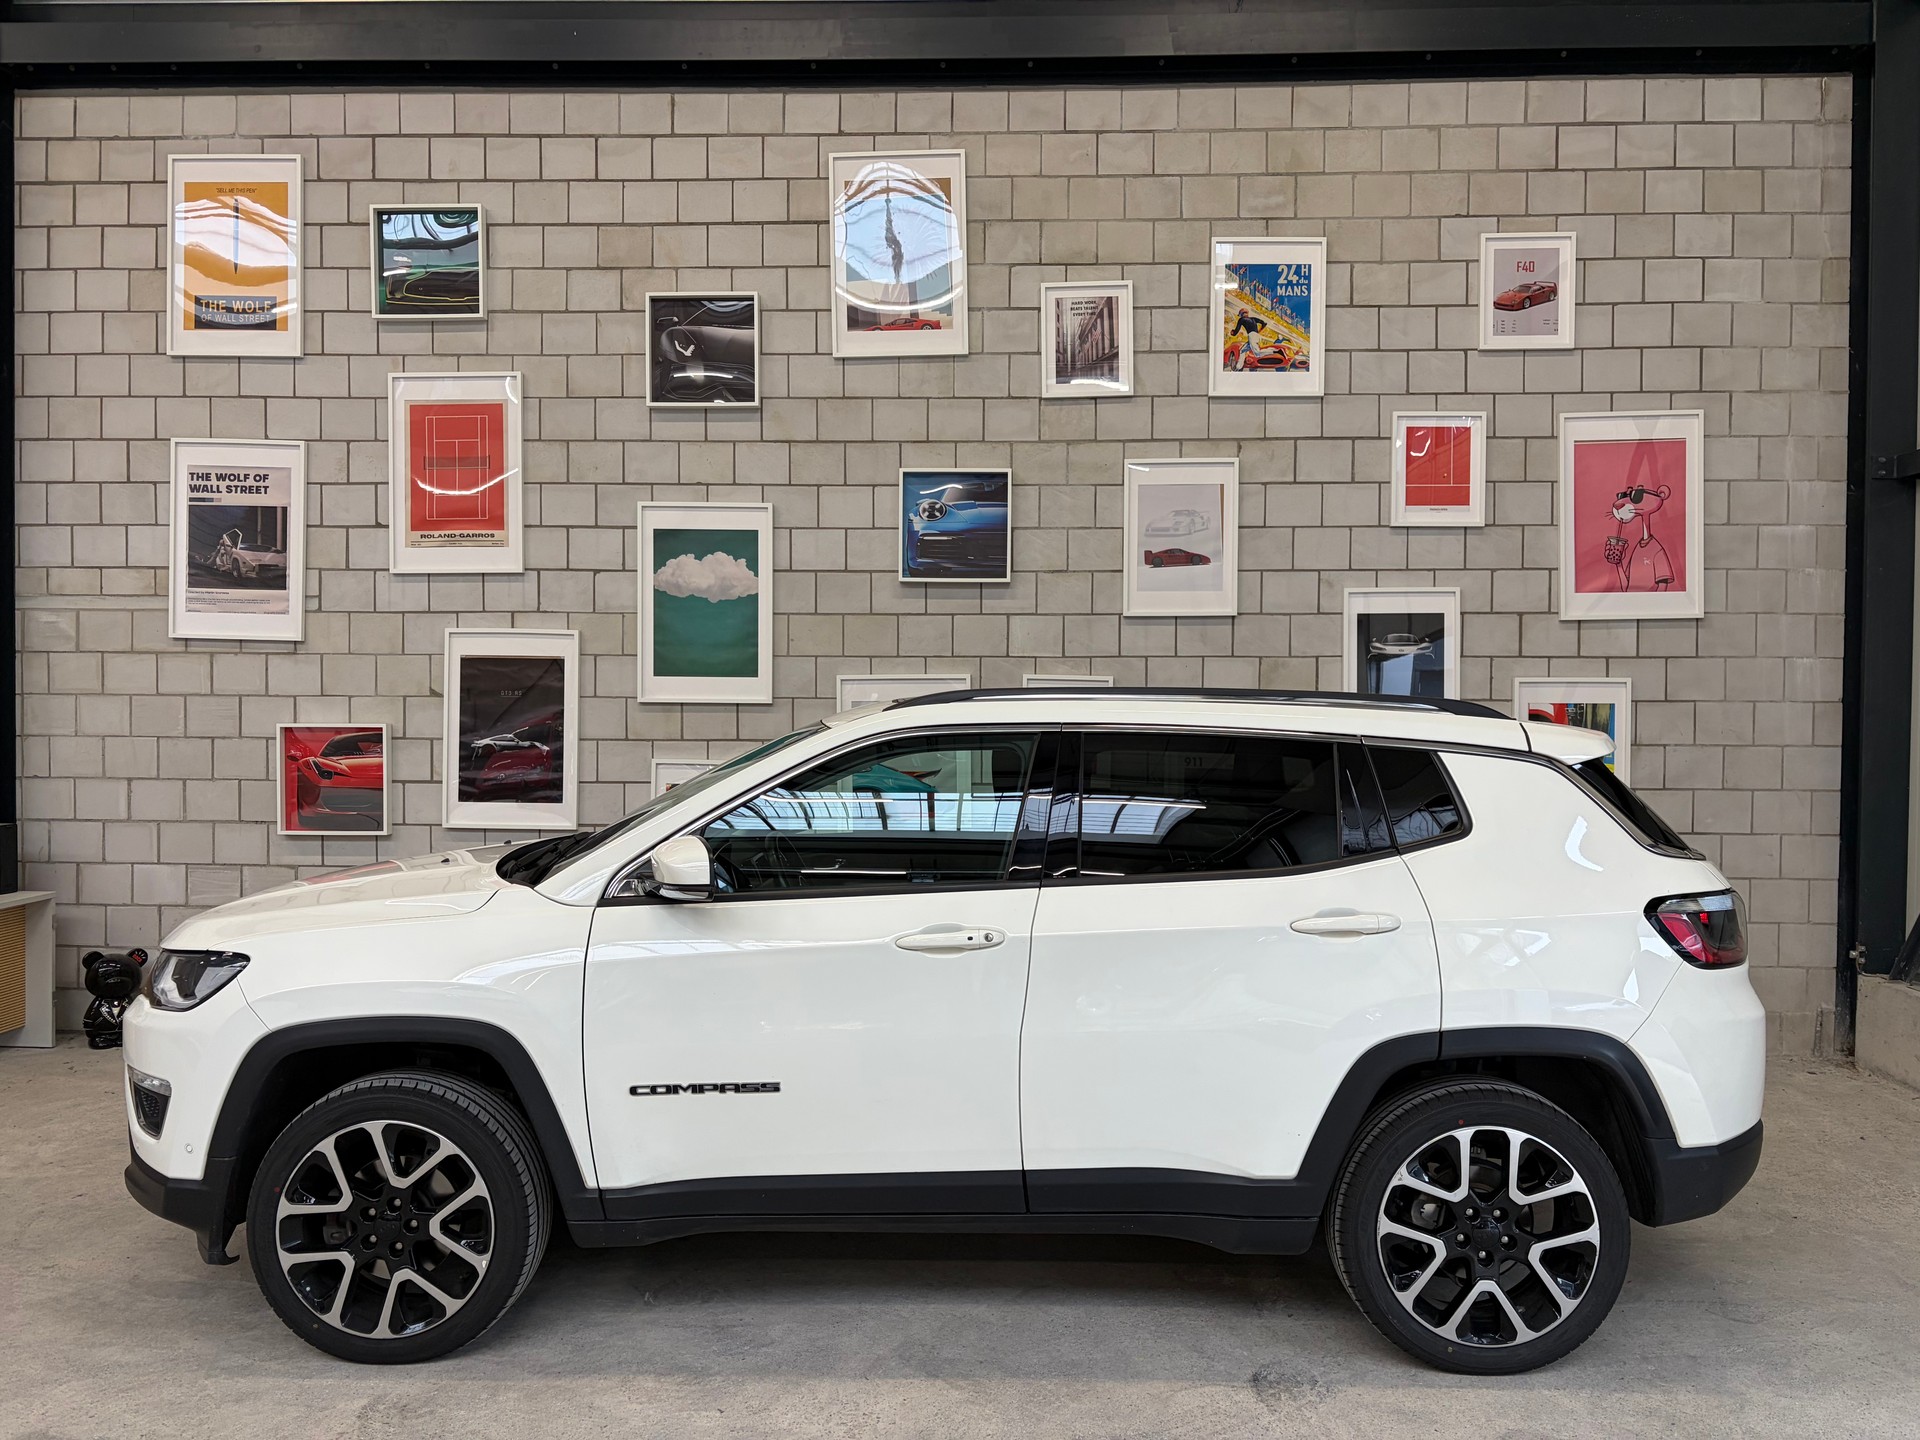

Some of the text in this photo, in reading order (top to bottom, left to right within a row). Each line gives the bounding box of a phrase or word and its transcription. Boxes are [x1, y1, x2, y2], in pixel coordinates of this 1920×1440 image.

[1516, 260, 1535, 273] F40
[1277, 264, 1309, 284] 24 H
[1277, 285, 1309, 296] MANS
[200, 300, 272, 313] THE WOLF
[201, 313, 271, 323] OF WALL STREET
[188, 472, 270, 483] THE WOLF OF
[188, 484, 270, 495] WALL STREET
[420, 532, 496, 540] ROLAND-GARROS
[1184, 756, 1203, 767] 911
[629, 1082, 781, 1097] COMPASS
